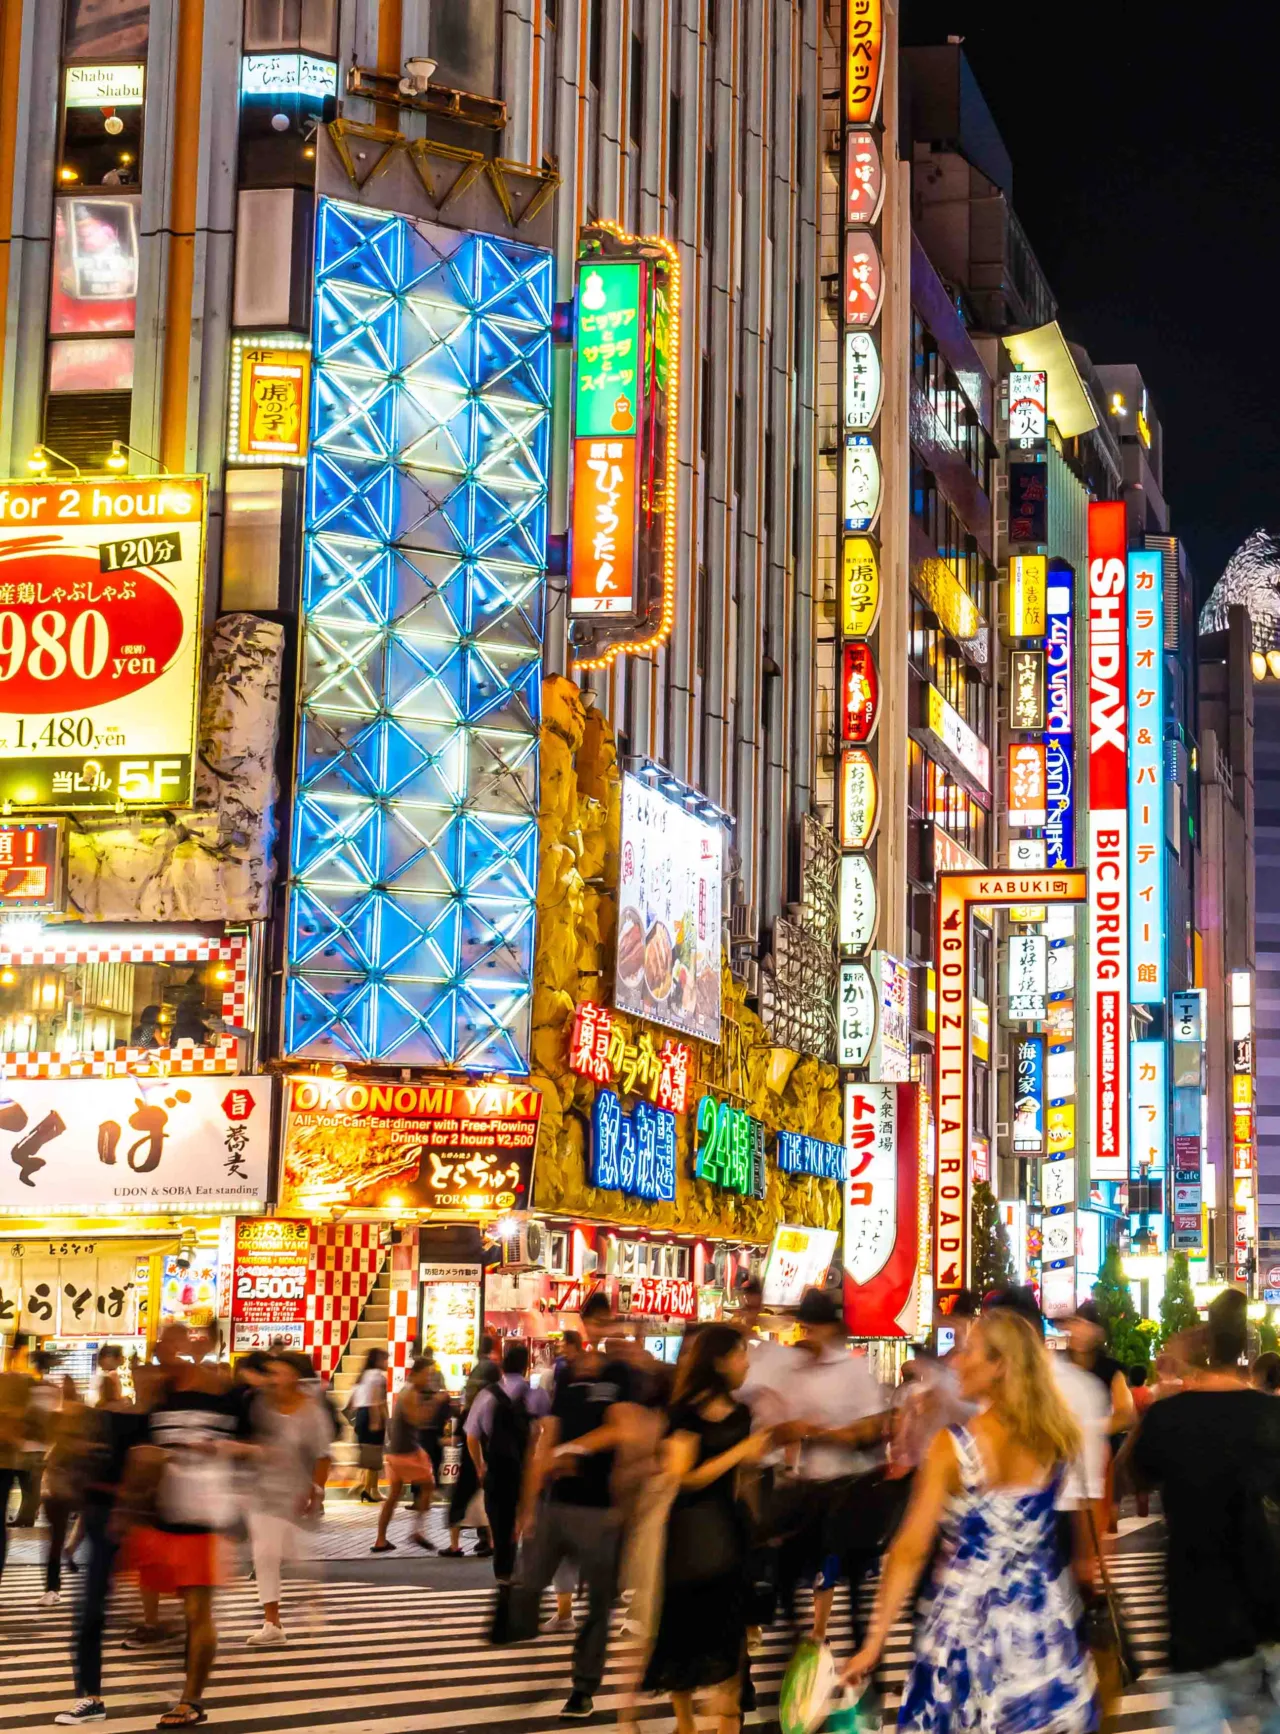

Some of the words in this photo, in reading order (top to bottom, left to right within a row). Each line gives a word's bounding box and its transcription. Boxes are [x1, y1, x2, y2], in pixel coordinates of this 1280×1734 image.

[71, 70, 114, 83] Shabu
[97, 84, 139, 97] Shabu
[849, 312, 869, 321] 7F
[247, 352, 274, 362] 4F
[585, 340, 632, 362] サラダ
[580, 368, 634, 391] スイーツ
[260, 383, 288, 431] 虎の子
[848, 411, 870, 424] 6F
[1020, 438, 1034, 449] 8F
[58, 489, 80, 518] 2
[92, 488, 194, 517] hours
[586, 458, 624, 593] ひょうたん
[851, 519, 865, 530] 5F
[106, 537, 175, 571] 120分
[849, 565, 874, 612] 虎の子
[594, 599, 613, 610] 7F
[847, 623, 863, 631] 4F
[1090, 557, 1127, 753] SHIDAX
[112, 657, 156, 679] yen
[14, 717, 94, 751] 1,480
[94, 732, 127, 749] yen
[118, 760, 182, 801] 5F
[850, 765, 865, 837] お好み焼き
[1046, 753, 1064, 855] SHINJUKU
[1096, 829, 1120, 881] BIC
[1096, 892, 1120, 980] DRUG
[845, 944, 862, 954] 1F
[843, 972, 864, 982] 新宿
[1101, 995, 1115, 1019] BIC
[942, 938, 962, 1134] GODZILLA
[844, 1047, 862, 1058] B1
[1018, 1042, 1037, 1093] 海の家
[295, 1083, 453, 1114] OKONOMI
[464, 1091, 537, 1117] YAKI
[294, 1116, 390, 1130] All-You-Can-Eat
[393, 1119, 431, 1131] dinner
[434, 1120, 458, 1131] with
[461, 1120, 535, 1133] Free-Flowing
[878, 1086, 894, 1152] 大衆酒場
[391, 1131, 429, 1145] Drinks
[431, 1133, 449, 1145] for
[452, 1134, 459, 1145] 2
[461, 1133, 495, 1145] hours
[497, 1135, 534, 1148] ¥2,500
[850, 1095, 876, 1206] トラノコ
[1176, 1170, 1199, 1180] Cafe
[113, 1187, 148, 1197] UDON
[151, 1187, 160, 1196] &
[162, 1186, 193, 1196] SOBA
[195, 1186, 213, 1195] Eat
[216, 1185, 259, 1197] standing
[499, 1195, 513, 1205] 2F
[940, 1159, 961, 1253] ROAD
[239, 1223, 307, 1239] お好み焼き
[1179, 1221, 1197, 1229] 729
[49, 1243, 97, 1255] とらそば
[238, 1241, 282, 1251] OKONOMI
[284, 1240, 308, 1250] YAKI
[424, 1268, 478, 1276] 防犯カメラ作動中
